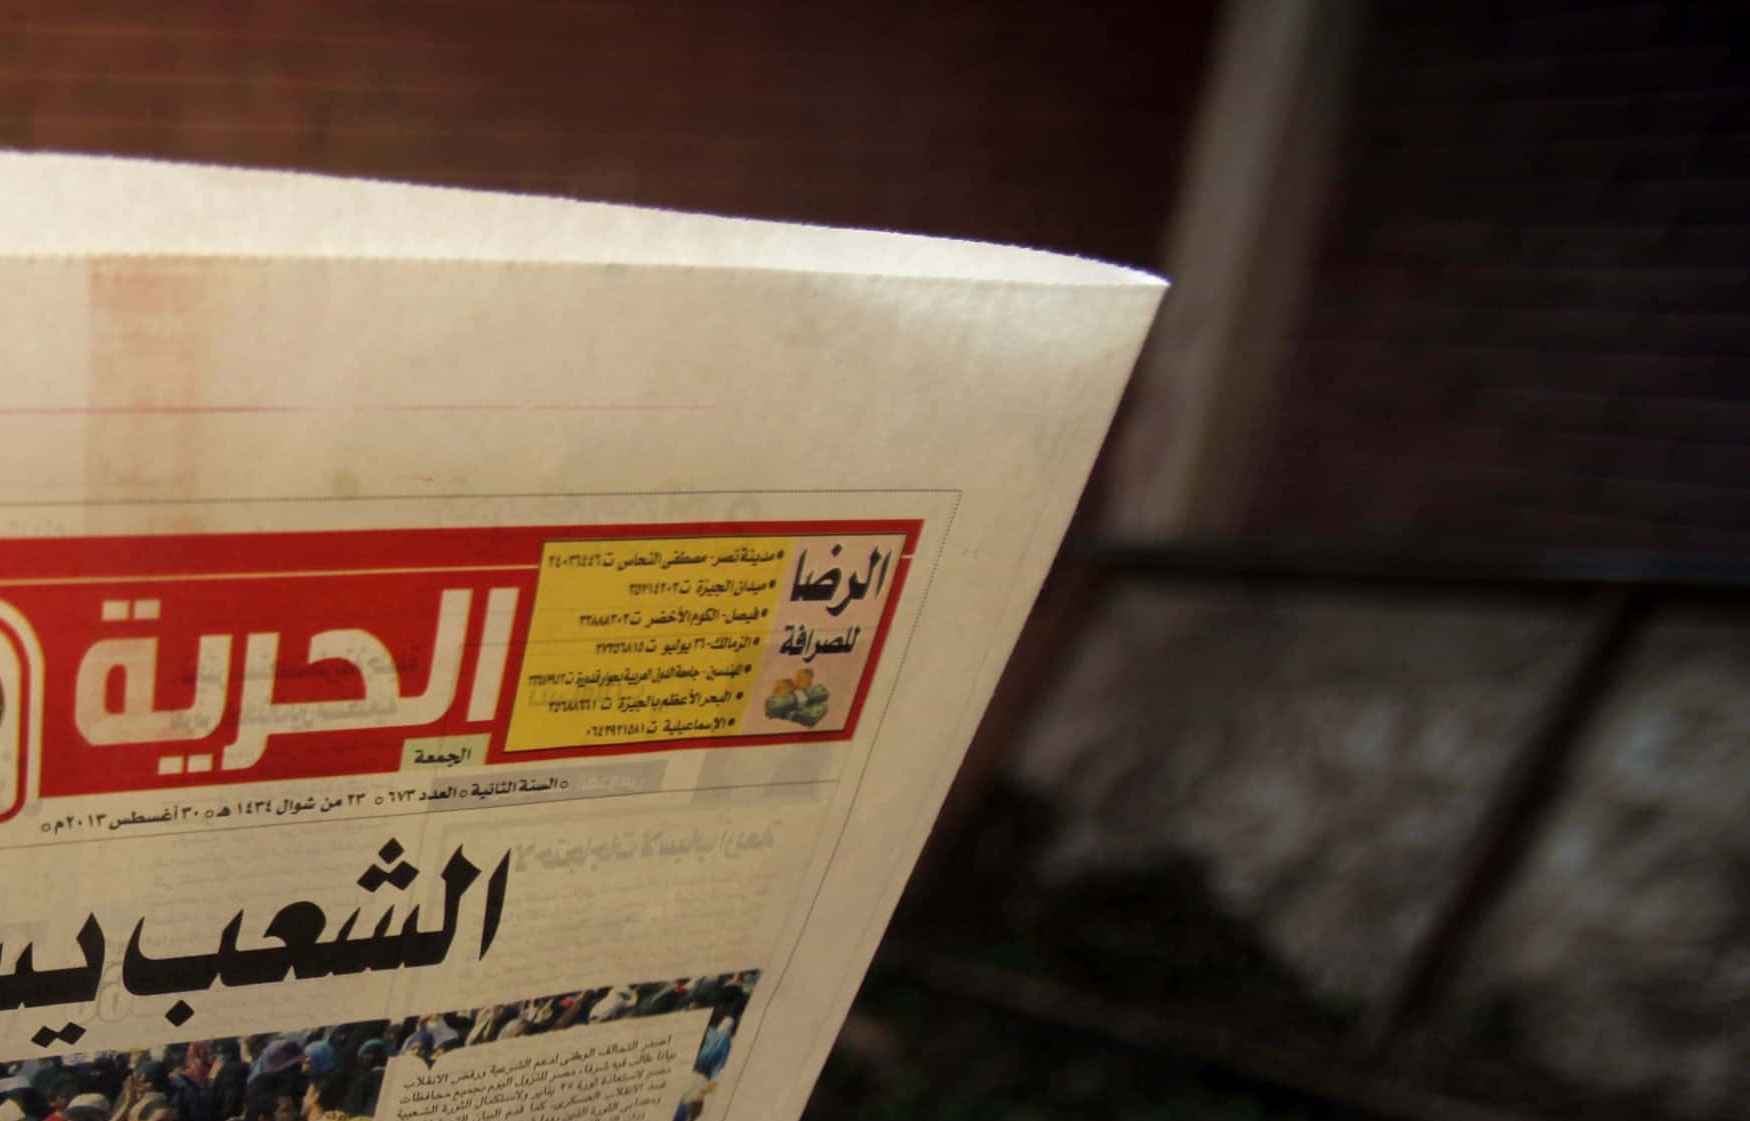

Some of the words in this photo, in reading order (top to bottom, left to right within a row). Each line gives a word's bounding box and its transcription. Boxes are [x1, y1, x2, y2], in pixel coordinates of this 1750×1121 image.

[791, 543, 893, 617] الرضا
[779, 624, 862, 664] للصرافة
[74, 586, 521, 776] الحرية
[412, 746, 473, 769] الجمعة
[347, 792, 367, 808] ٢٣
[418, 783, 458, 802] العدد
[236, 800, 272, 818] ١٤٣٤
[276, 795, 317, 816] شوال
[321, 797, 344, 814] من
[108, 806, 180, 831] أغسطس
[122, 837, 512, 1028] الشعب
